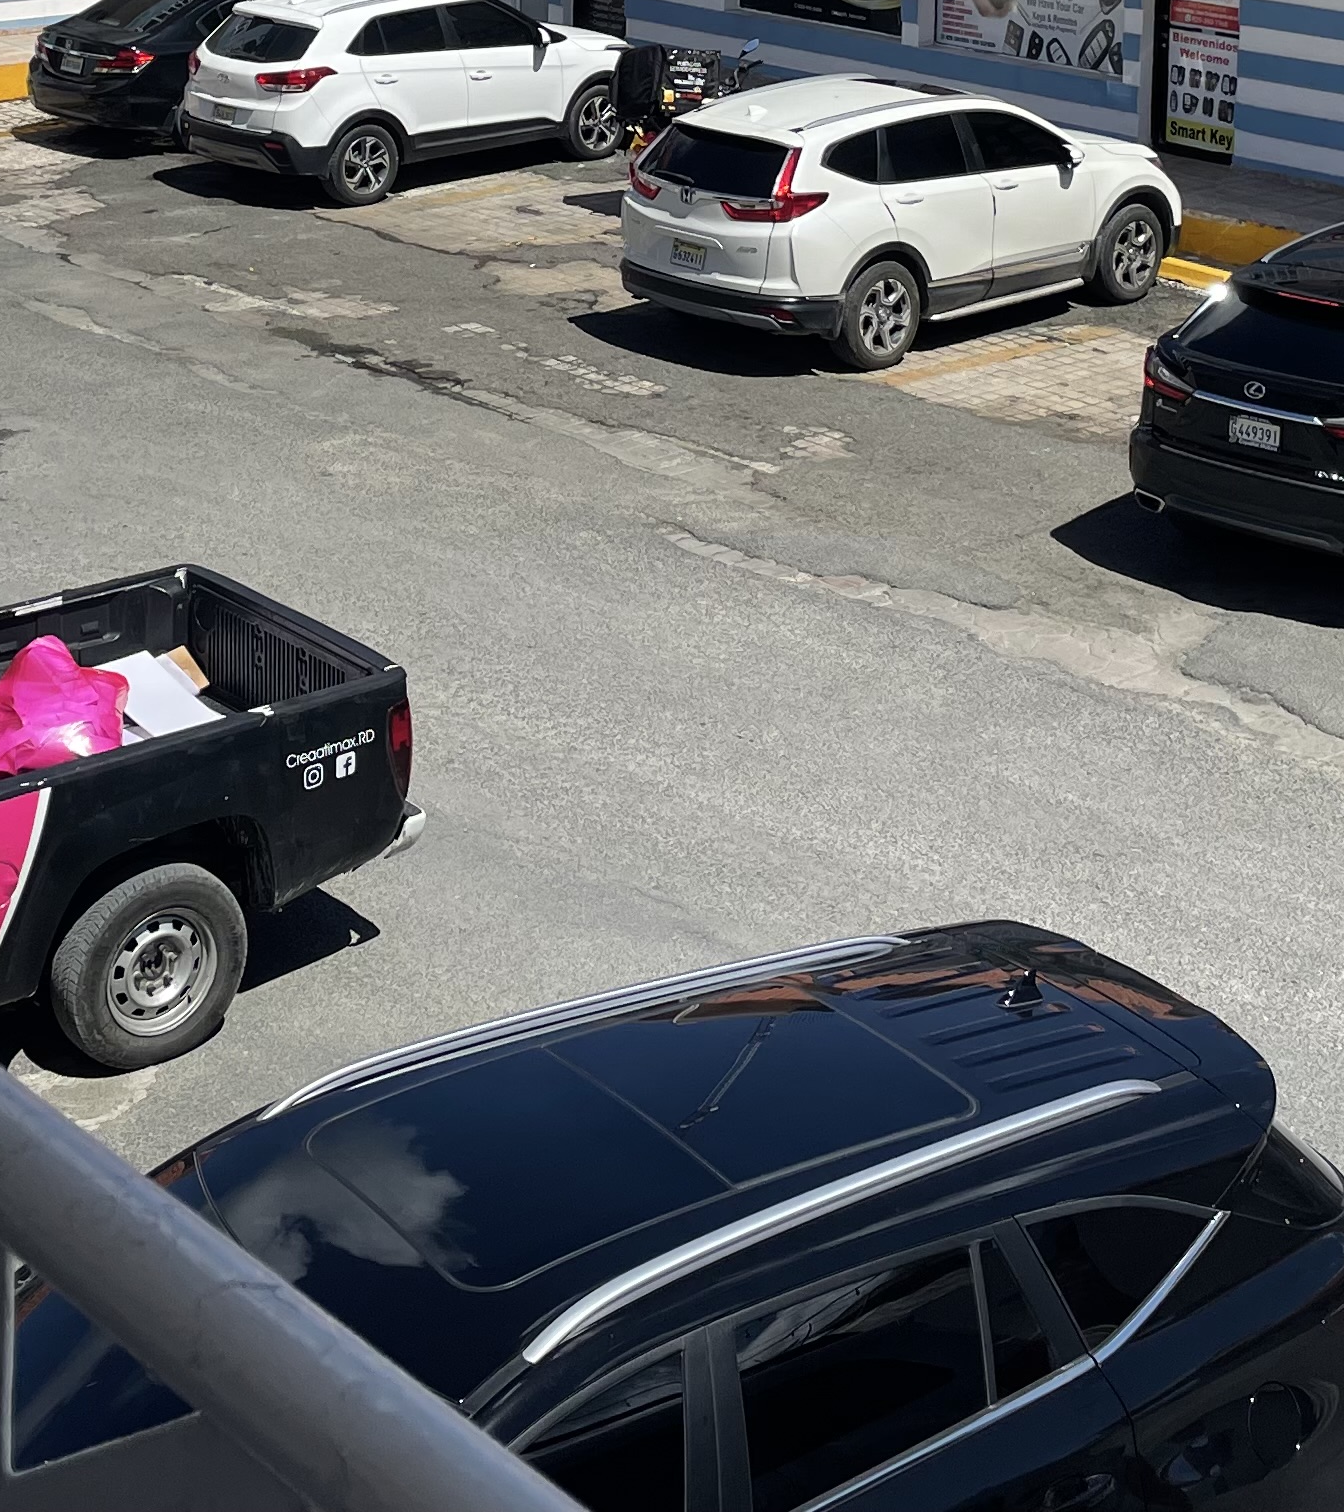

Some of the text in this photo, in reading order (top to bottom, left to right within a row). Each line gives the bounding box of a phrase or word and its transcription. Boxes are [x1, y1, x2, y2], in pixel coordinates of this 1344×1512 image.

[1172, 31, 1238, 54] Bienvenidos
[1179, 48, 1230, 66] Welcome
[1169, 120, 1233, 151] Smart Key
[1231, 419, 1278, 444] G449391
